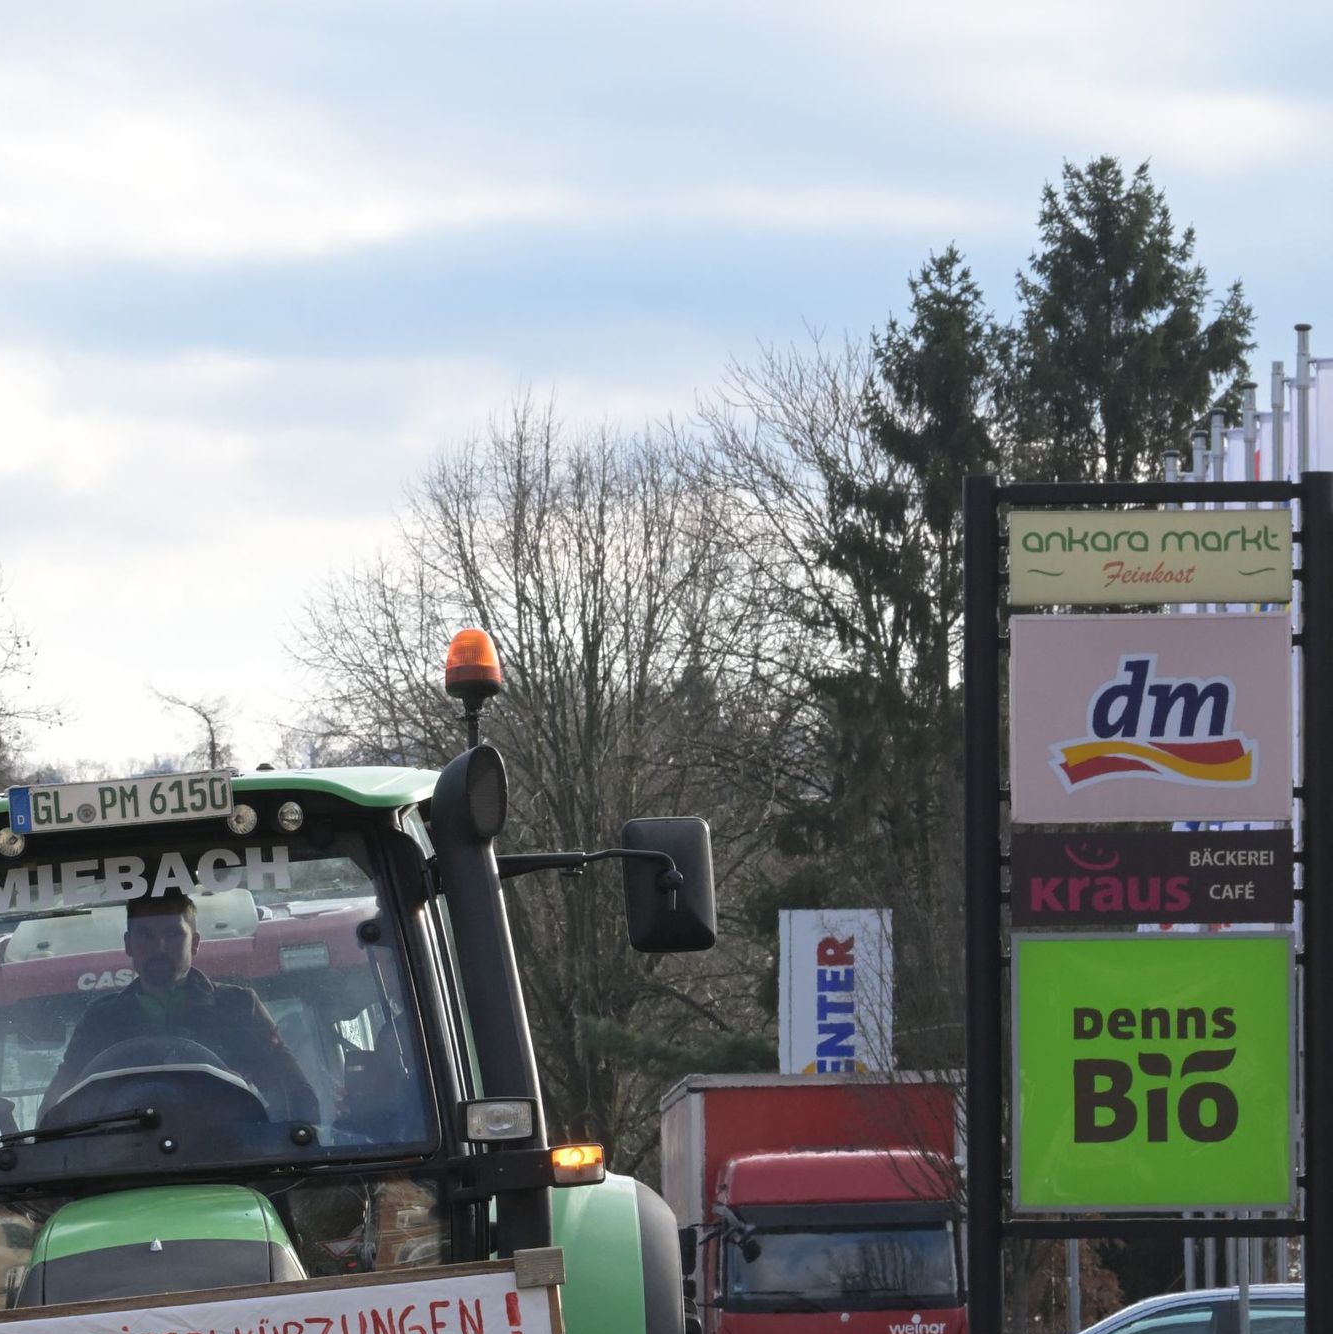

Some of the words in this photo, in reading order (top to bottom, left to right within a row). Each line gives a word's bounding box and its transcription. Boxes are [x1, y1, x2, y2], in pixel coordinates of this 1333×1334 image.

[1022, 527, 1149, 552] ankara
[1162, 525, 1281, 552] markt
[1102, 561, 1196, 588] Feinkost
[1092, 660, 1229, 738] dm
[33, 791, 73, 825] GL
[98, 785, 140, 820] PM
[150, 777, 227, 815] 6150
[1189, 850, 1274, 867] BÄCKEREI
[1209, 881, 1255, 900] CAFÉ
[1073, 1048, 1238, 1143] Bio
